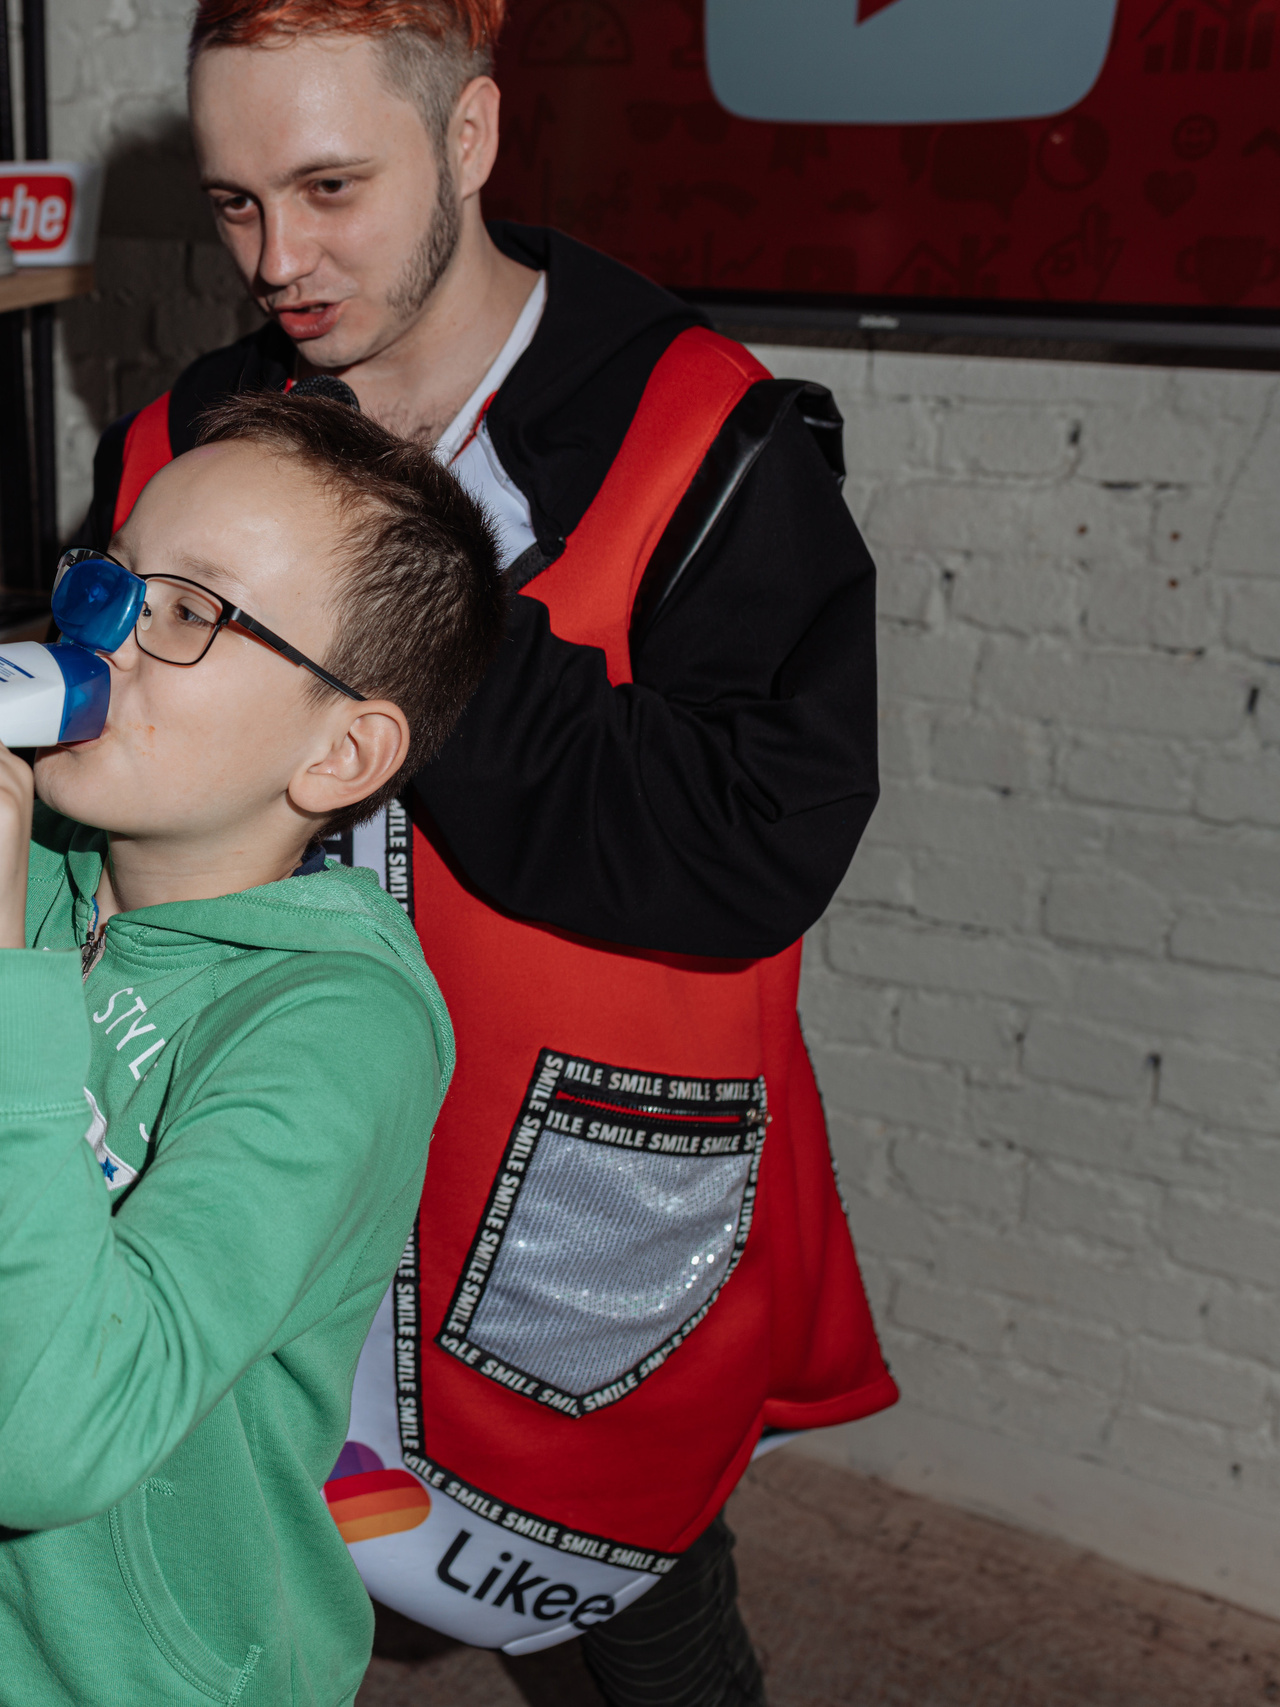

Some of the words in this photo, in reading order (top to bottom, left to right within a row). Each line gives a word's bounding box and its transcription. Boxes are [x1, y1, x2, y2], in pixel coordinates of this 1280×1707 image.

[387, 798, 408, 849] MILE
[388, 851, 409, 913] SMI
[92, 987, 167, 1082] STYL
[529, 1054, 564, 1113] SMILE
[607, 1071, 663, 1097] SMILE
[667, 1080, 711, 1102] SMILE
[714, 1082, 750, 1102] SMILE
[506, 1114, 542, 1172] SMILE
[586, 1120, 646, 1148] SMILE
[647, 1131, 701, 1155] SMILE
[699, 1134, 741, 1155] SMILE
[485, 1172, 520, 1230] SMILE
[466, 1228, 500, 1285] SMILE
[396, 1282, 417, 1337] SMILE
[446, 1283, 481, 1334] SMILE
[397, 1337, 417, 1392] SMILE
[479, 1358, 540, 1396] SMILE
[537, 1388, 581, 1419] SMIL
[582, 1372, 639, 1412] SMILE
[398, 1396, 419, 1450] SMILE
[444, 1480, 504, 1522] SMILE
[501, 1511, 560, 1544] SMILE
[558, 1532, 611, 1560] SMILE
[607, 1547, 656, 1570] SMILE
[436, 1529, 616, 1630] Likee
